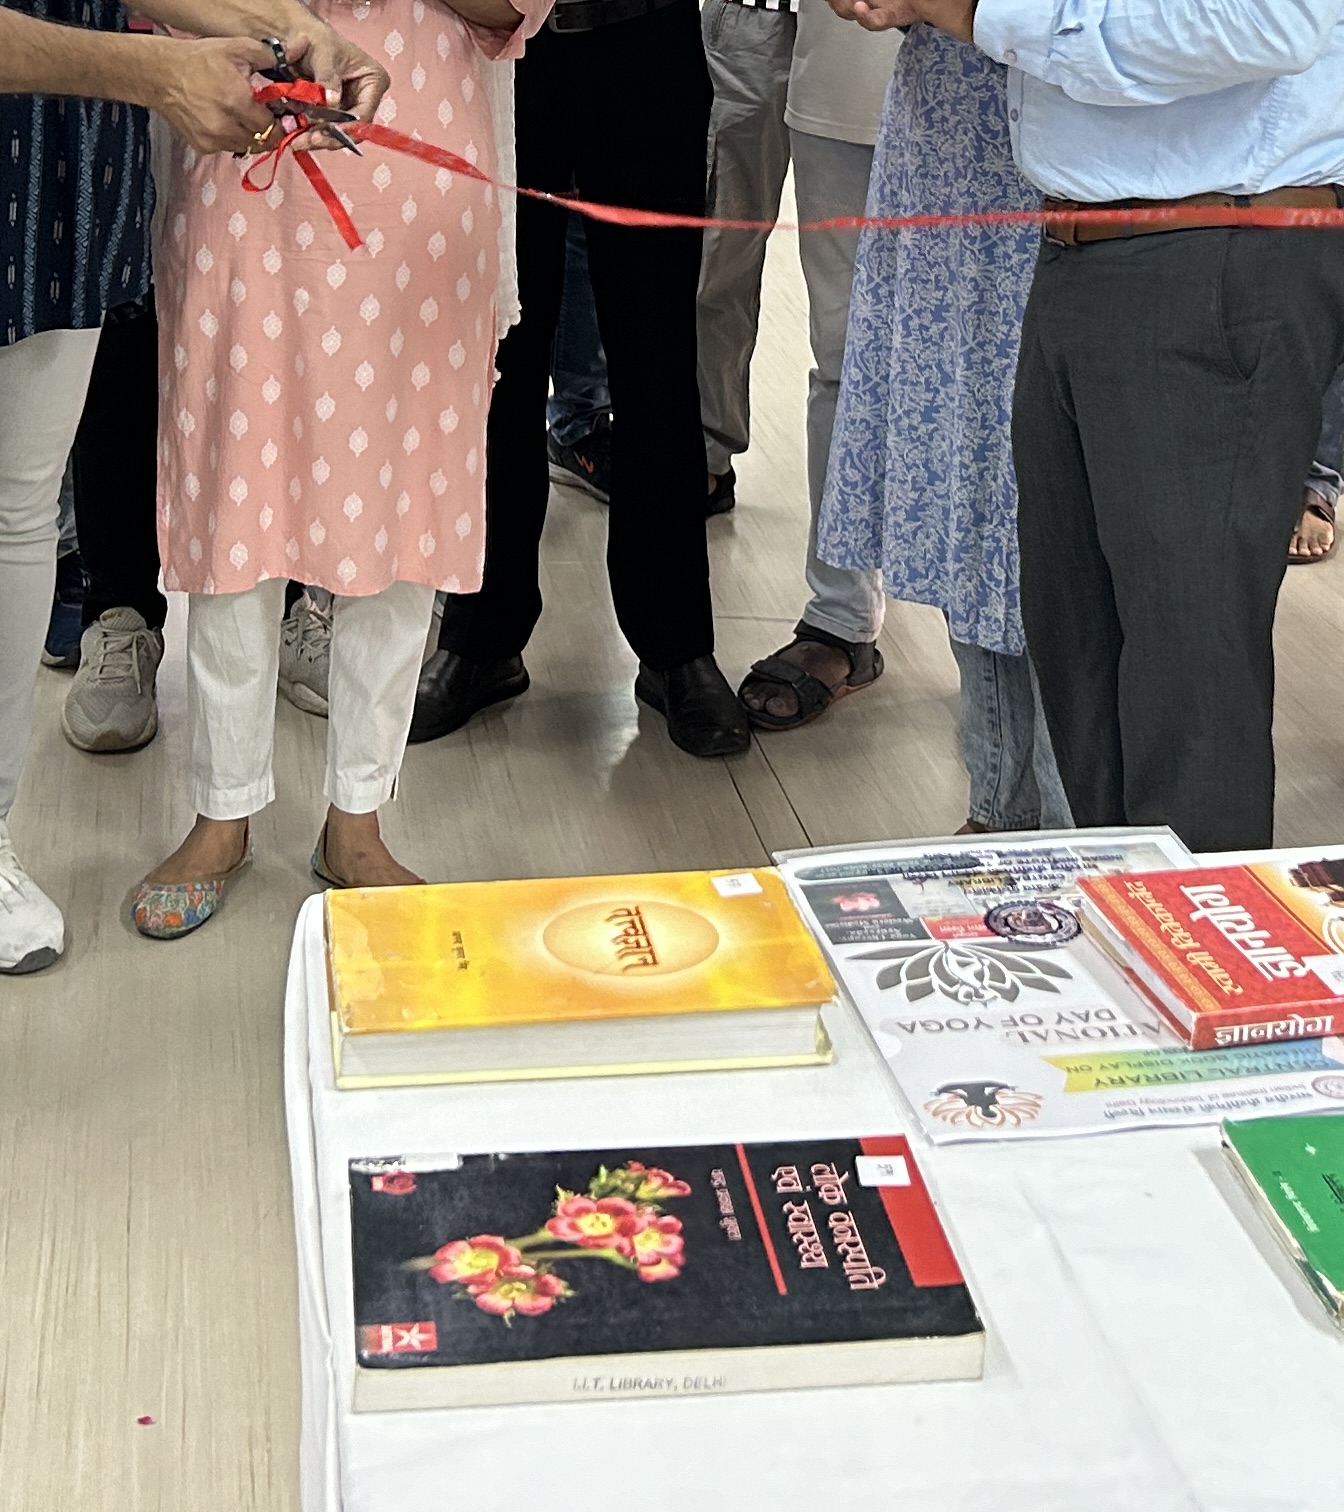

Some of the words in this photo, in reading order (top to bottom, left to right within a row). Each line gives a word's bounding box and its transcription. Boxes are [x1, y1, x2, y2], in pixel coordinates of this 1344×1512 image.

[1180, 883, 1311, 982] ज्ञानयोग
[897, 1015, 995, 1034] YOGA
[1002, 1013, 1043, 1029] OF
[1051, 1008, 1117, 1025] DAY
[1005, 1022, 1163, 1044] ATIONAL
[1214, 1013, 1334, 1044] ज्ञानयोग
[1065, 1063, 1092, 1074] ON
[1095, 1056, 1185, 1071] DISPLAY
[1206, 1058, 1330, 1080] CENTRAL
[1094, 1070, 1203, 1089] LIBRARY
[771, 1165, 812, 1195] एवं
[810, 1162, 849, 1205] लोक
[783, 1200, 830, 1270] स्वास्थ्य
[827, 1210, 887, 1291] वनस्पति
